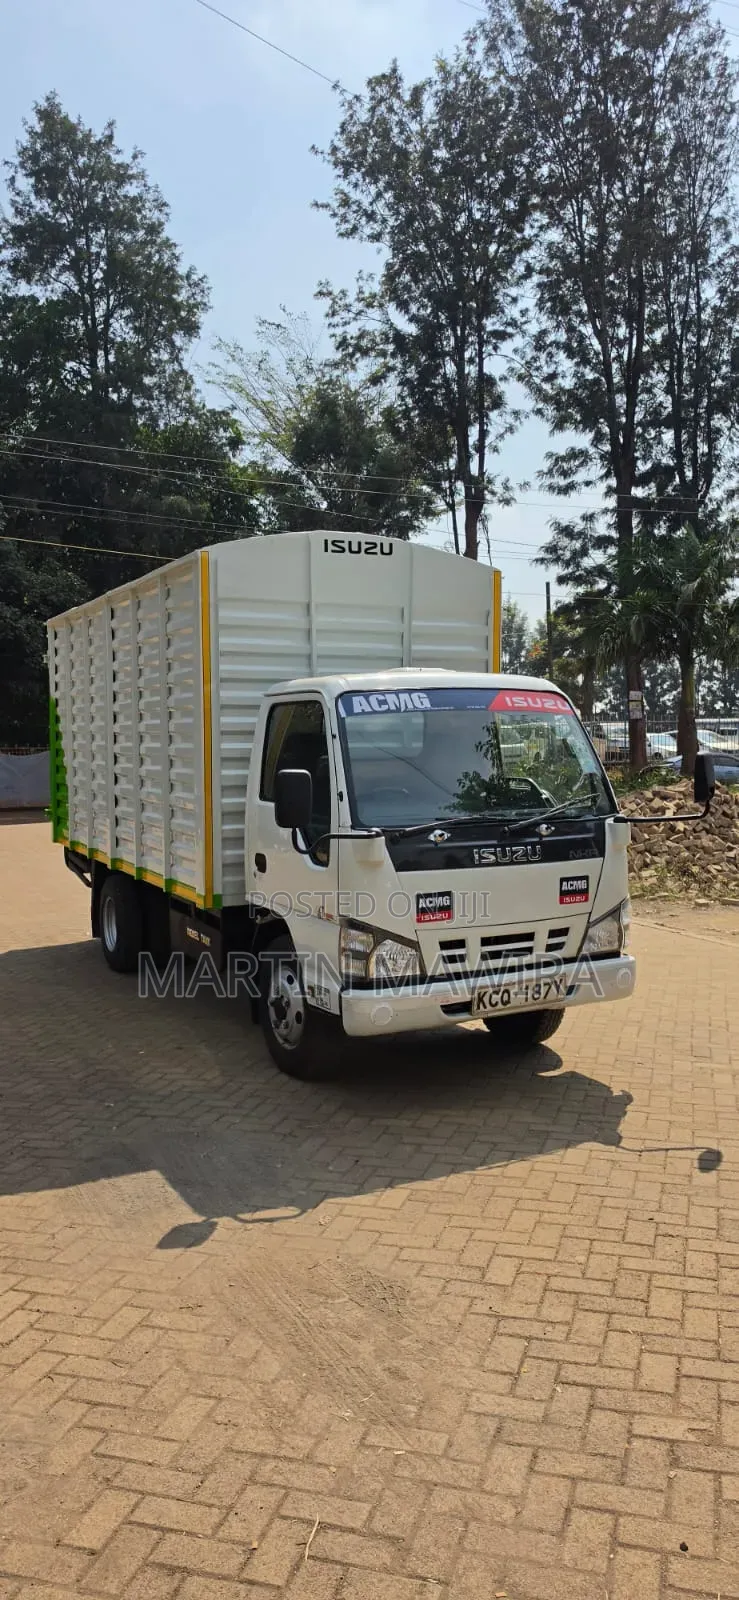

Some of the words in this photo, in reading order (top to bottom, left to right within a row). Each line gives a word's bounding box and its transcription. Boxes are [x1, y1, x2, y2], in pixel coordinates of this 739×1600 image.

[324, 539, 393, 555] ISUZU
[352, 692, 431, 713] ACMG
[505, 696, 570, 710] ISUZU
[473, 845, 541, 864] ISUZU
[561, 880, 587, 891] ACMG
[418, 896, 450, 909] ACMG
[563, 895, 585, 903] ISUZU
[421, 912, 449, 921] ISUZU
[476, 989, 511, 1010] KCQ
[525, 978, 563, 1002] 187Y
